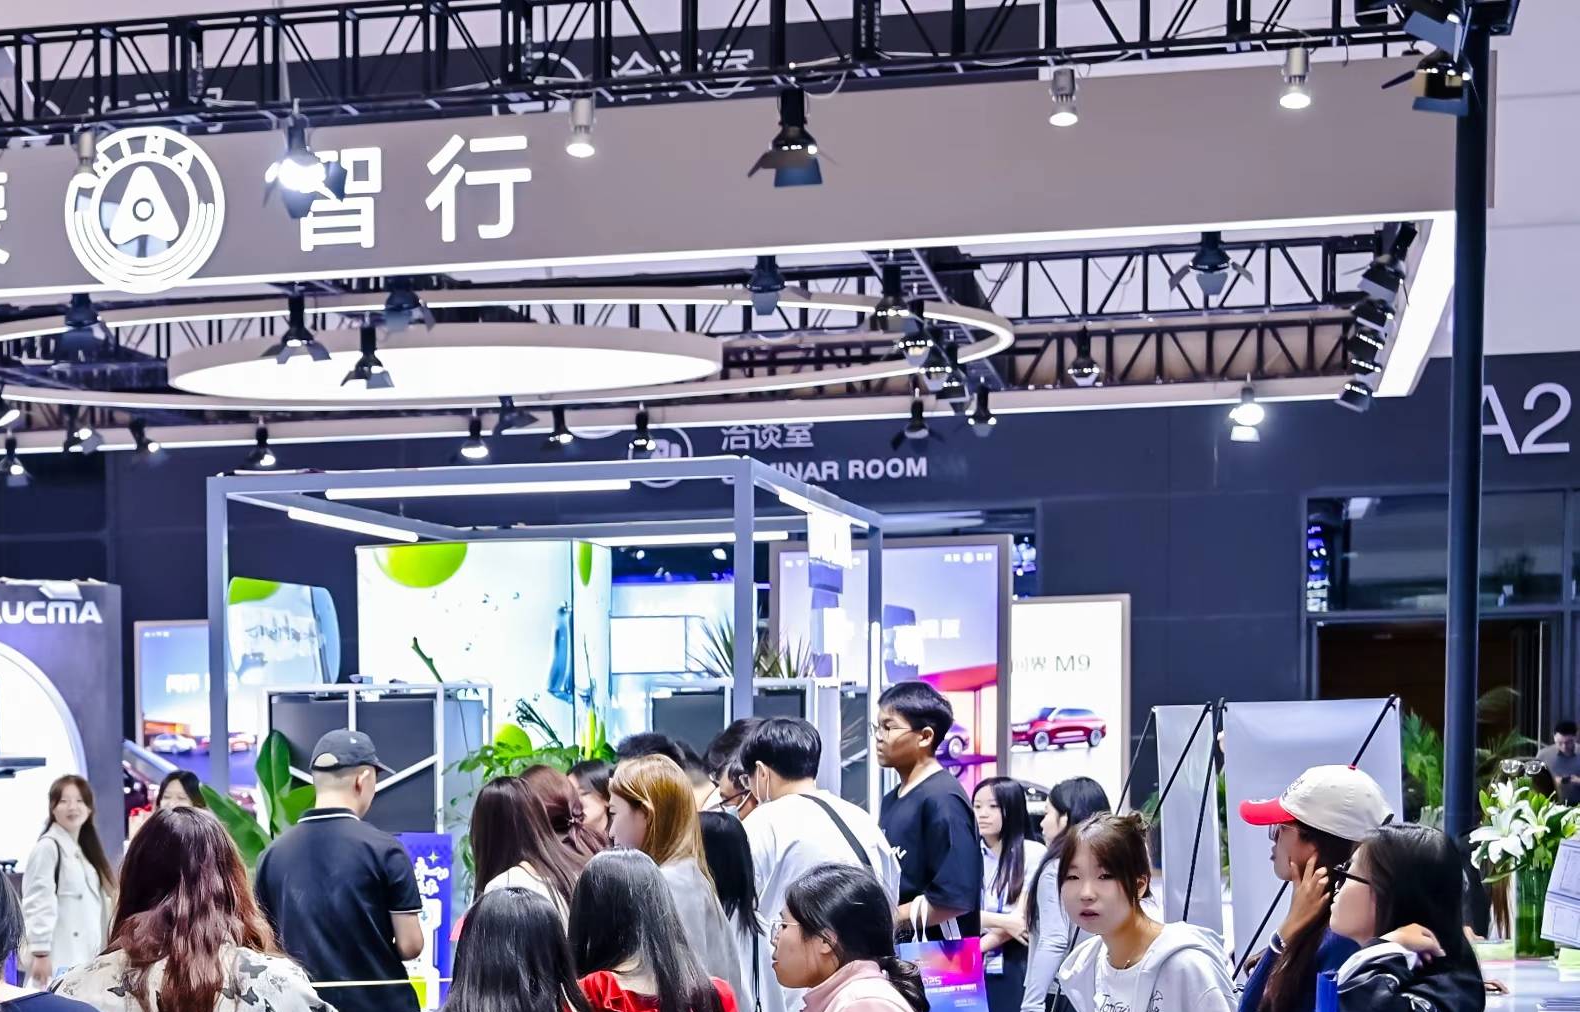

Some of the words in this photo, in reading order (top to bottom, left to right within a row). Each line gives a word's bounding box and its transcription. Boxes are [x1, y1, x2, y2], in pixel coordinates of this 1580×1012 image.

[1480, 381, 1573, 455] A2
[720, 422, 815, 451] 洽谈室
[847, 456, 928, 480] ROOM
[1054, 654, 1091, 672] M9
